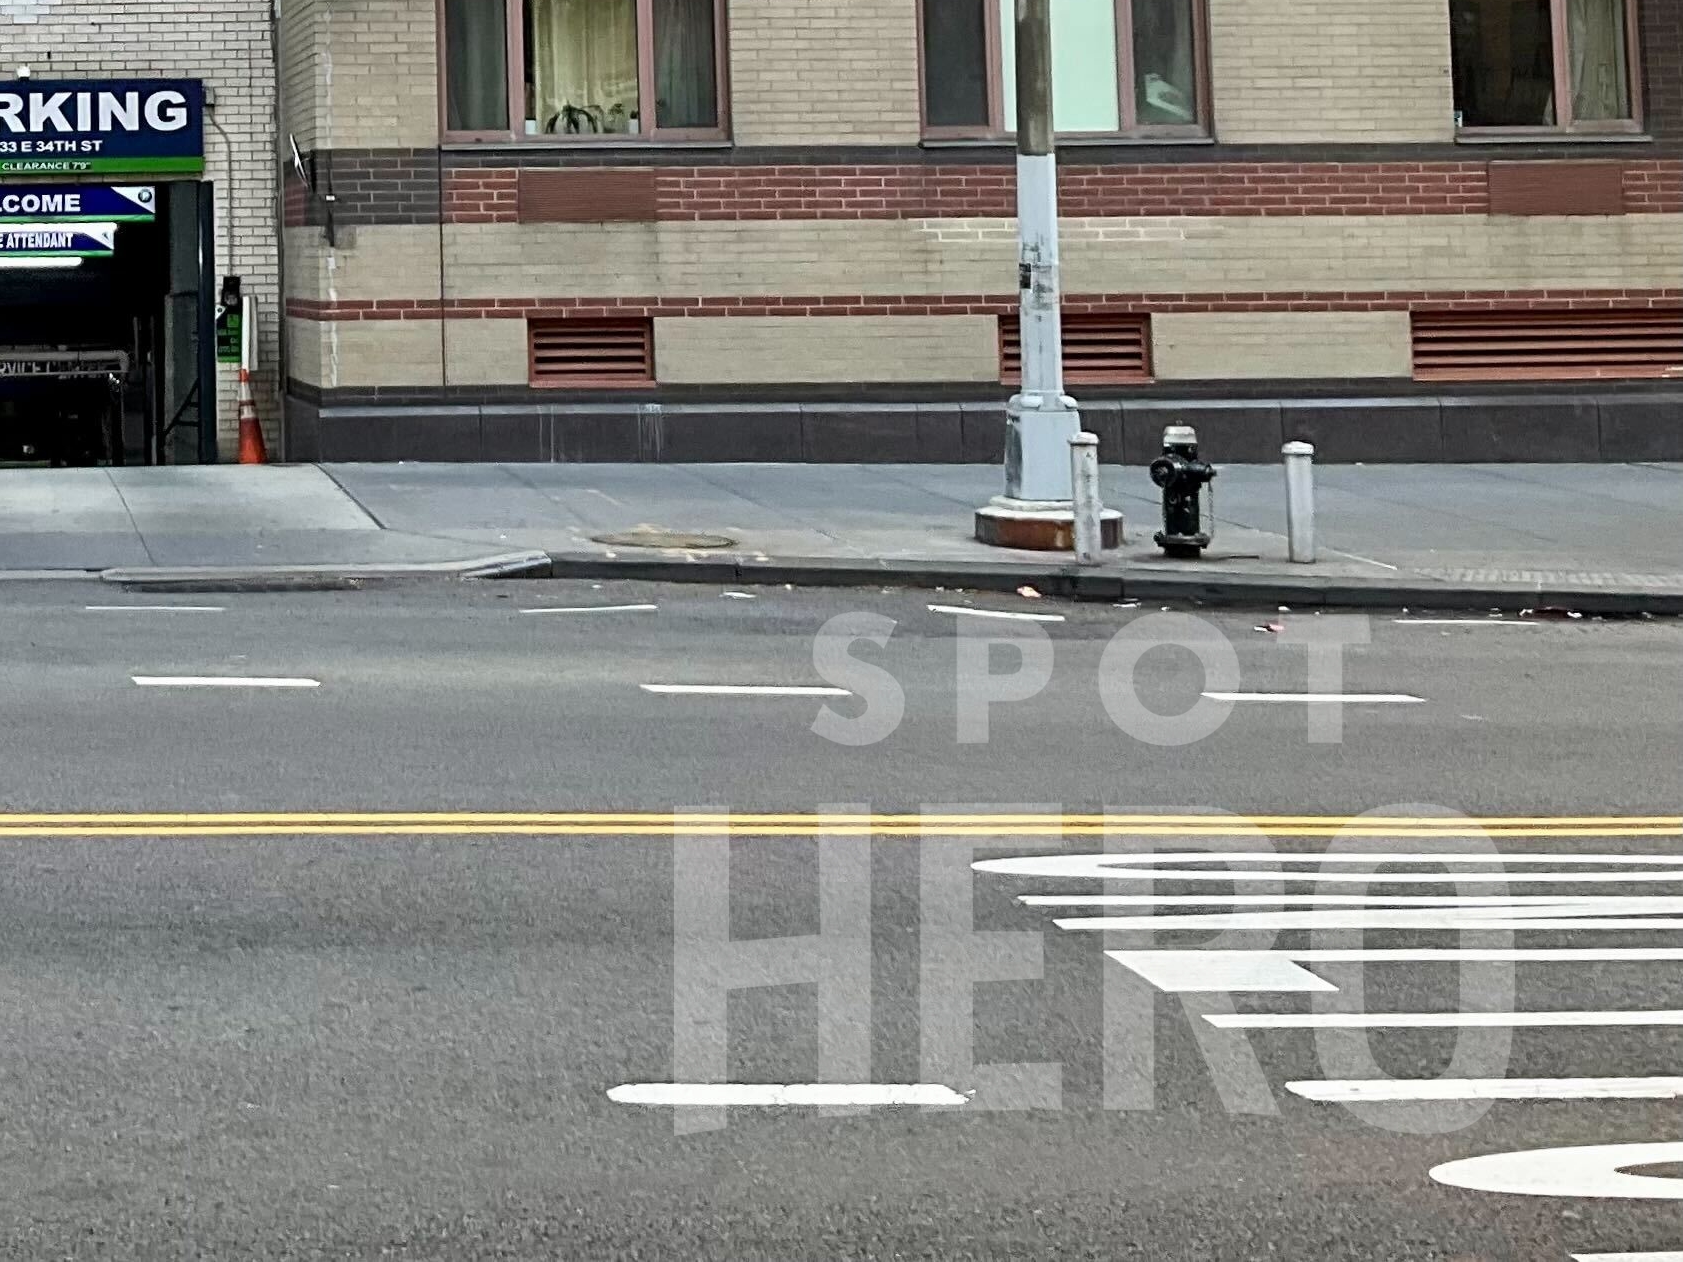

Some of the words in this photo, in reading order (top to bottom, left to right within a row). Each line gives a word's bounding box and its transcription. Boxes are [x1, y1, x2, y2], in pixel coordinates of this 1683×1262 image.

[21, 140, 32, 152] E
[36, 140, 76, 152] 34TH
[80, 140, 103, 152] ST
[1, 161, 69, 171] CLEARANCE
[6, 232, 74, 248] ATTENDANT
